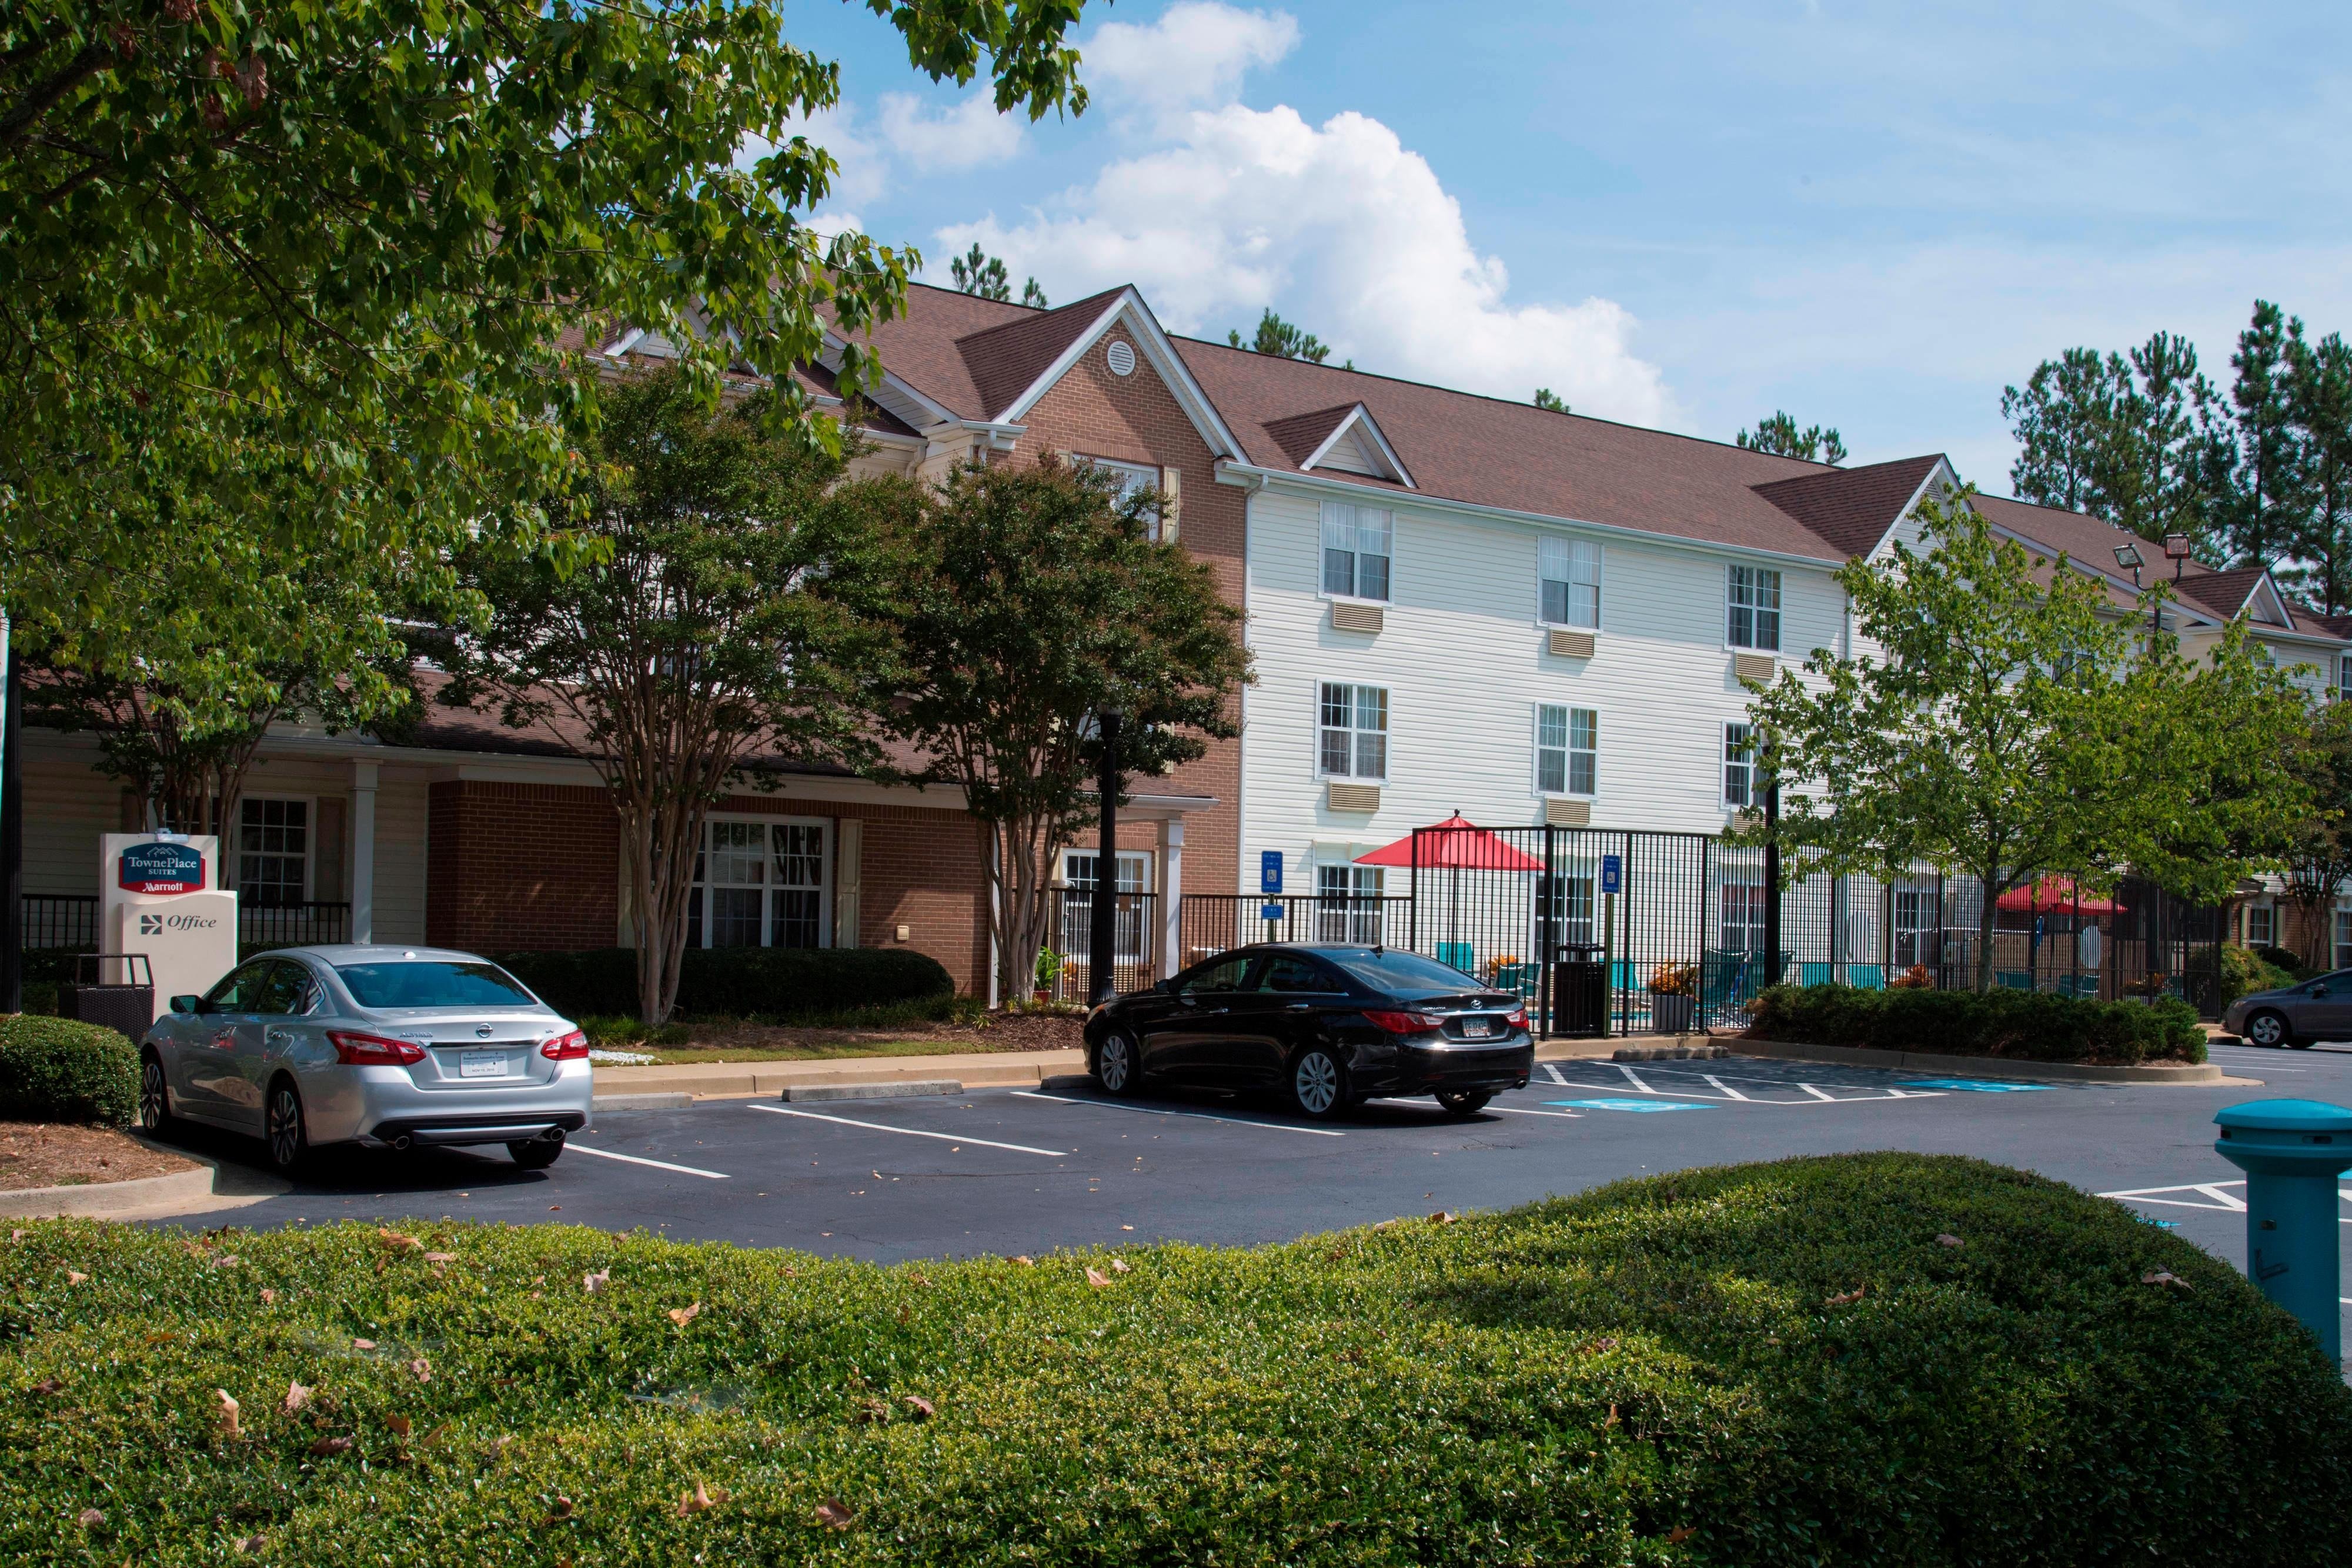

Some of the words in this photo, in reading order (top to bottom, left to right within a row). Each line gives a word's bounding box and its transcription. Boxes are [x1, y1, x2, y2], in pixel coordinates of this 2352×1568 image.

[128, 857, 197, 868] TownePlace
[142, 882, 183, 892] Marriott
[168, 915, 216, 930] Office
